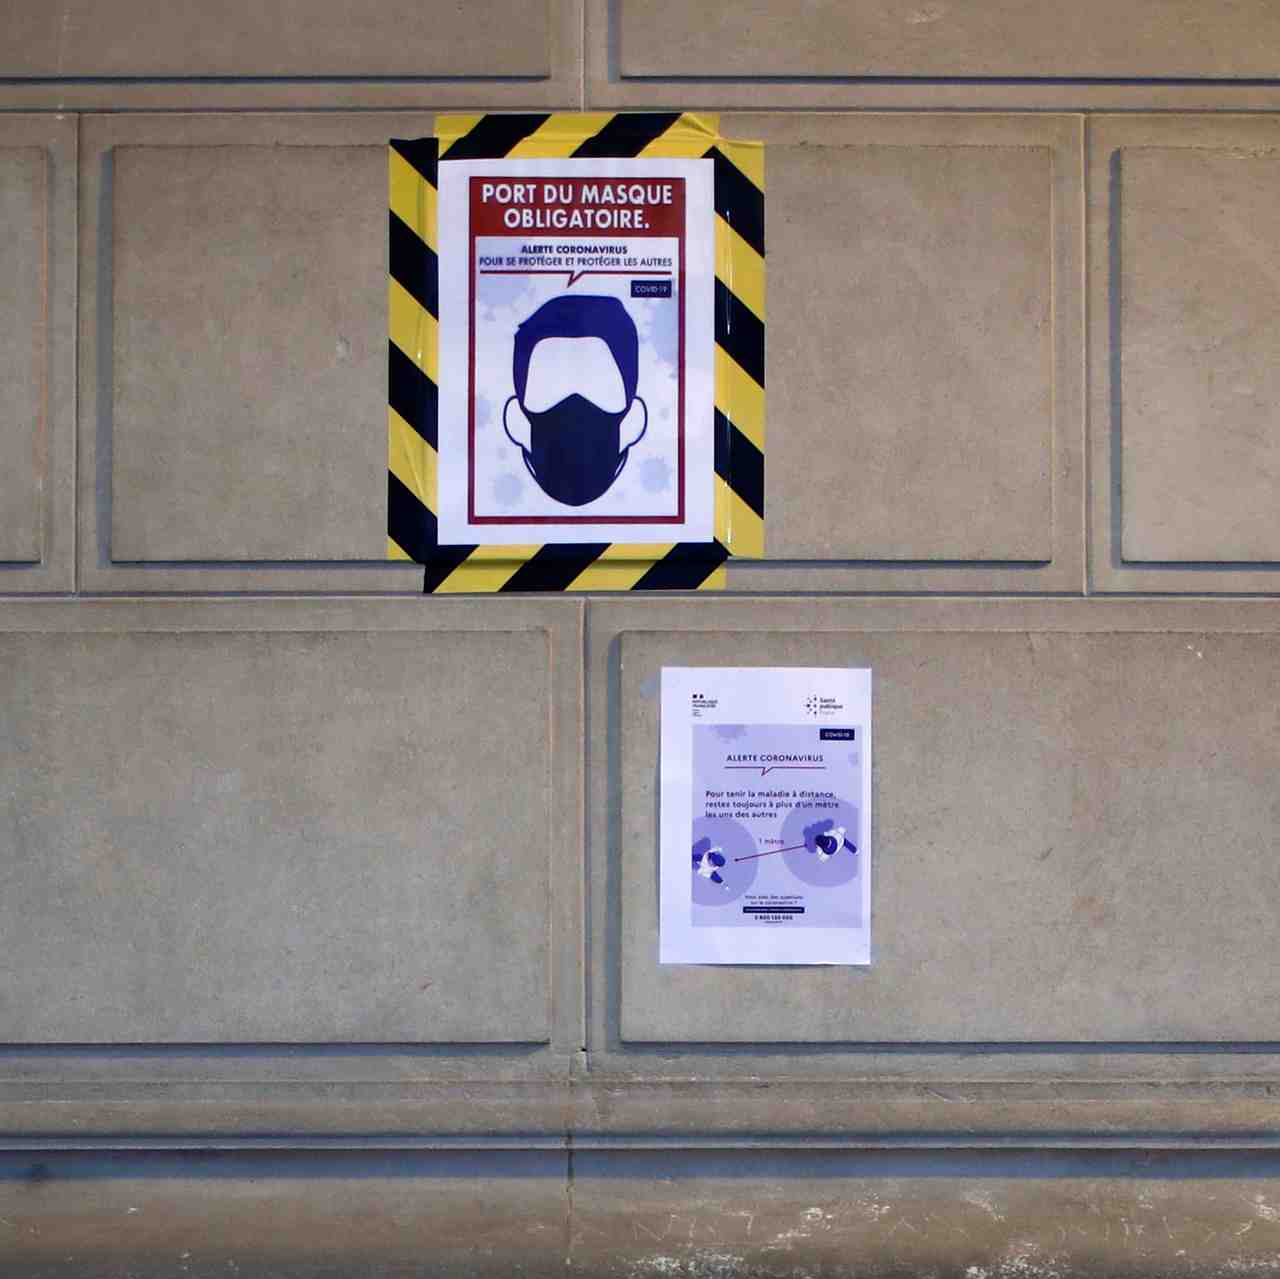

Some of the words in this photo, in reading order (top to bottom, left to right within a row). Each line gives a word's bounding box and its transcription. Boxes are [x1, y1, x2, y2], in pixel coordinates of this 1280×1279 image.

[481, 184, 536, 204] PORT
[543, 184, 573, 204] DU
[581, 184, 673, 205] MASQUE
[503, 208, 650, 229] OBLIGATOIRE.
[521, 245, 555, 254] ALERTE
[556, 245, 628, 254] CORONAVIRUS
[479, 257, 504, 266] POUR
[506, 257, 517, 266] SE
[518, 255, 563, 266] PROTÉGER
[565, 257, 575, 266] ET
[577, 255, 621, 266] PROTÉGER
[623, 257, 638, 266] LES
[640, 257, 673, 266] AUTRES
[726, 754, 757, 762] ALERTE
[760, 754, 824, 762] CORONAVIRUS
[705, 790, 724, 798] Pour
[726, 790, 746, 798] tenir
[748, 790, 756, 798] la
[757, 790, 790, 798] maladie
[733, 801, 767, 810] toujours
[775, 801, 793, 809] plus
